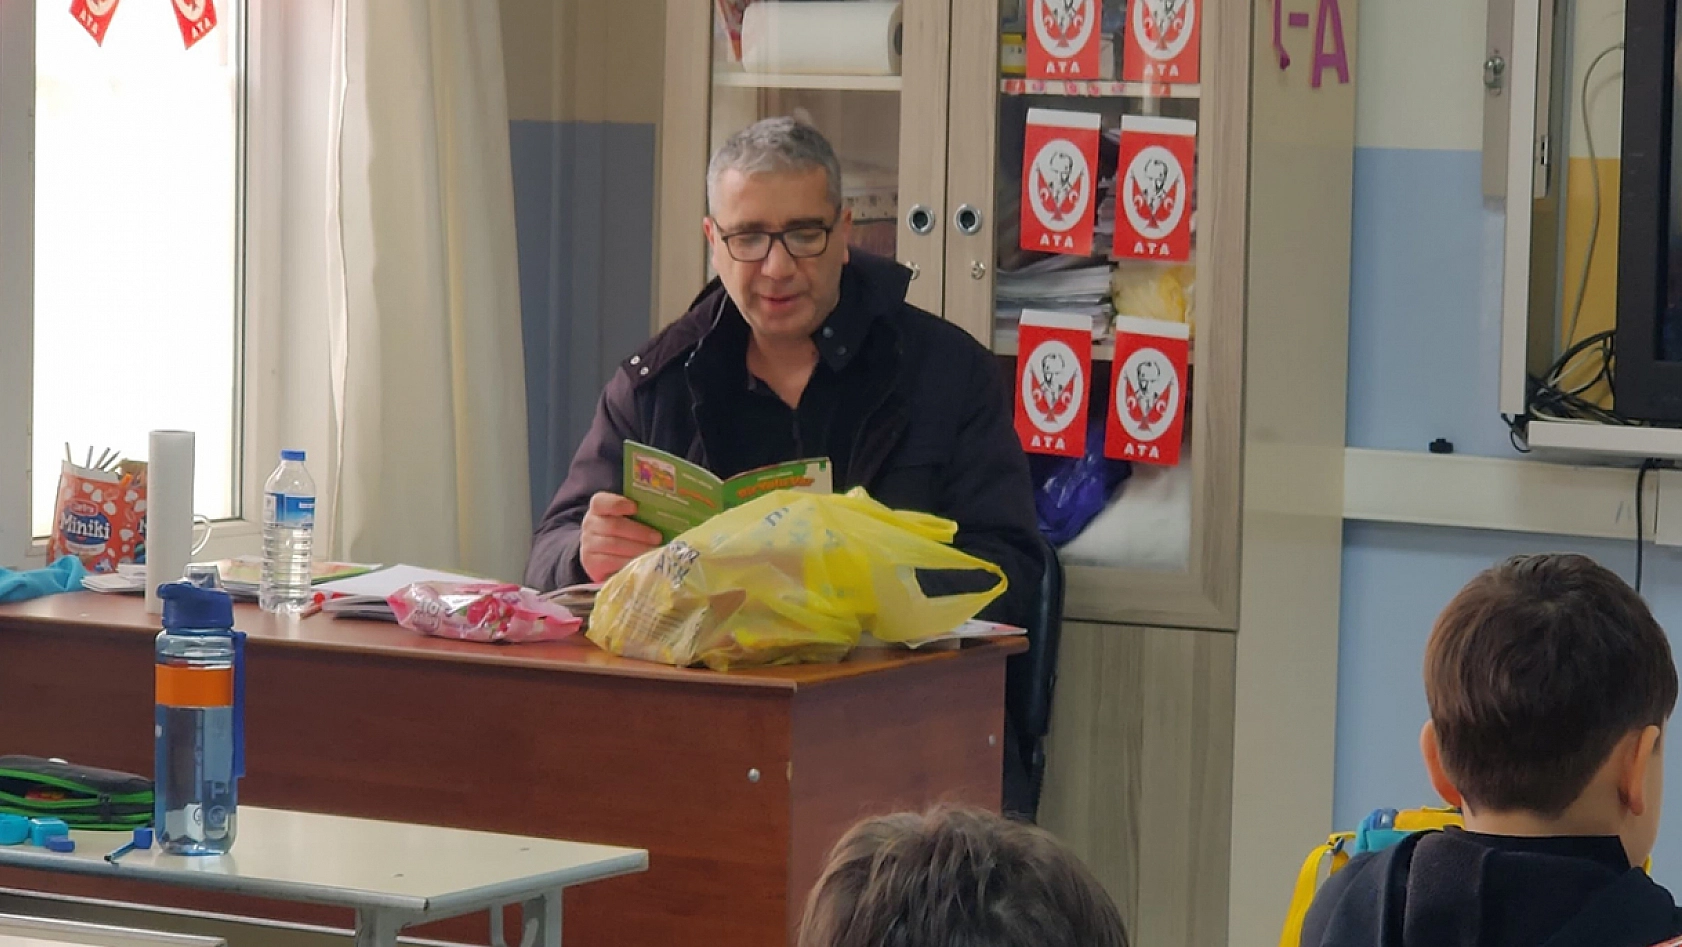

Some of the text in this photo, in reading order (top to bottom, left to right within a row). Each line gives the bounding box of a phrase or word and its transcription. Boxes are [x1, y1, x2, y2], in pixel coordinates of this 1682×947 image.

[79, 9, 98, 35] ATA
[191, 17, 211, 39] ATA
[1046, 61, 1080, 73] ATA
[1143, 63, 1179, 77] ATA
[1039, 233, 1074, 248] ATA
[1133, 242, 1170, 256] ATA
[1030, 435, 1066, 450] ATA
[1123, 443, 1160, 459] ATA
[59, 512, 110, 540] Miniki
